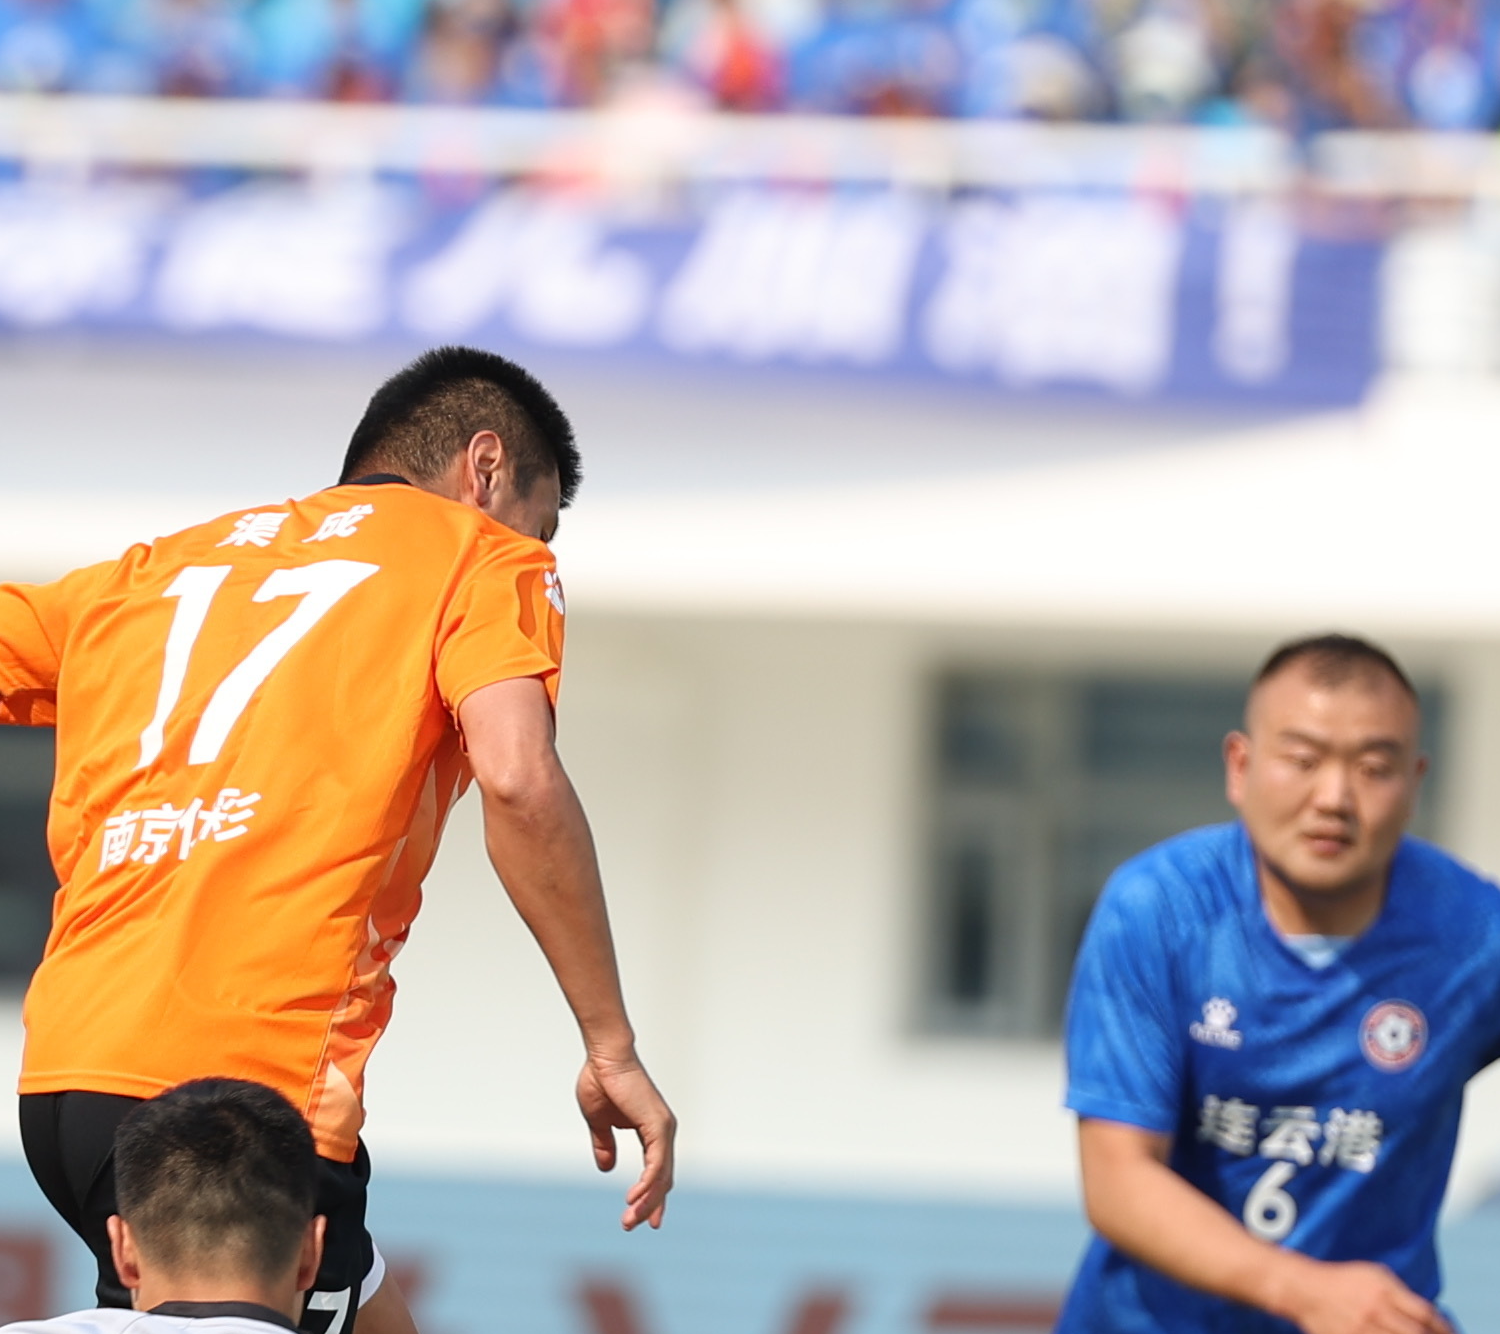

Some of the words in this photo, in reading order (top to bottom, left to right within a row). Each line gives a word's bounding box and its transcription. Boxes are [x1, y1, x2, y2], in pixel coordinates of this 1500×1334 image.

[214, 503, 376, 548] 渠成
[132, 558, 382, 772] 17
[1242, 1160, 1298, 1244] 6
